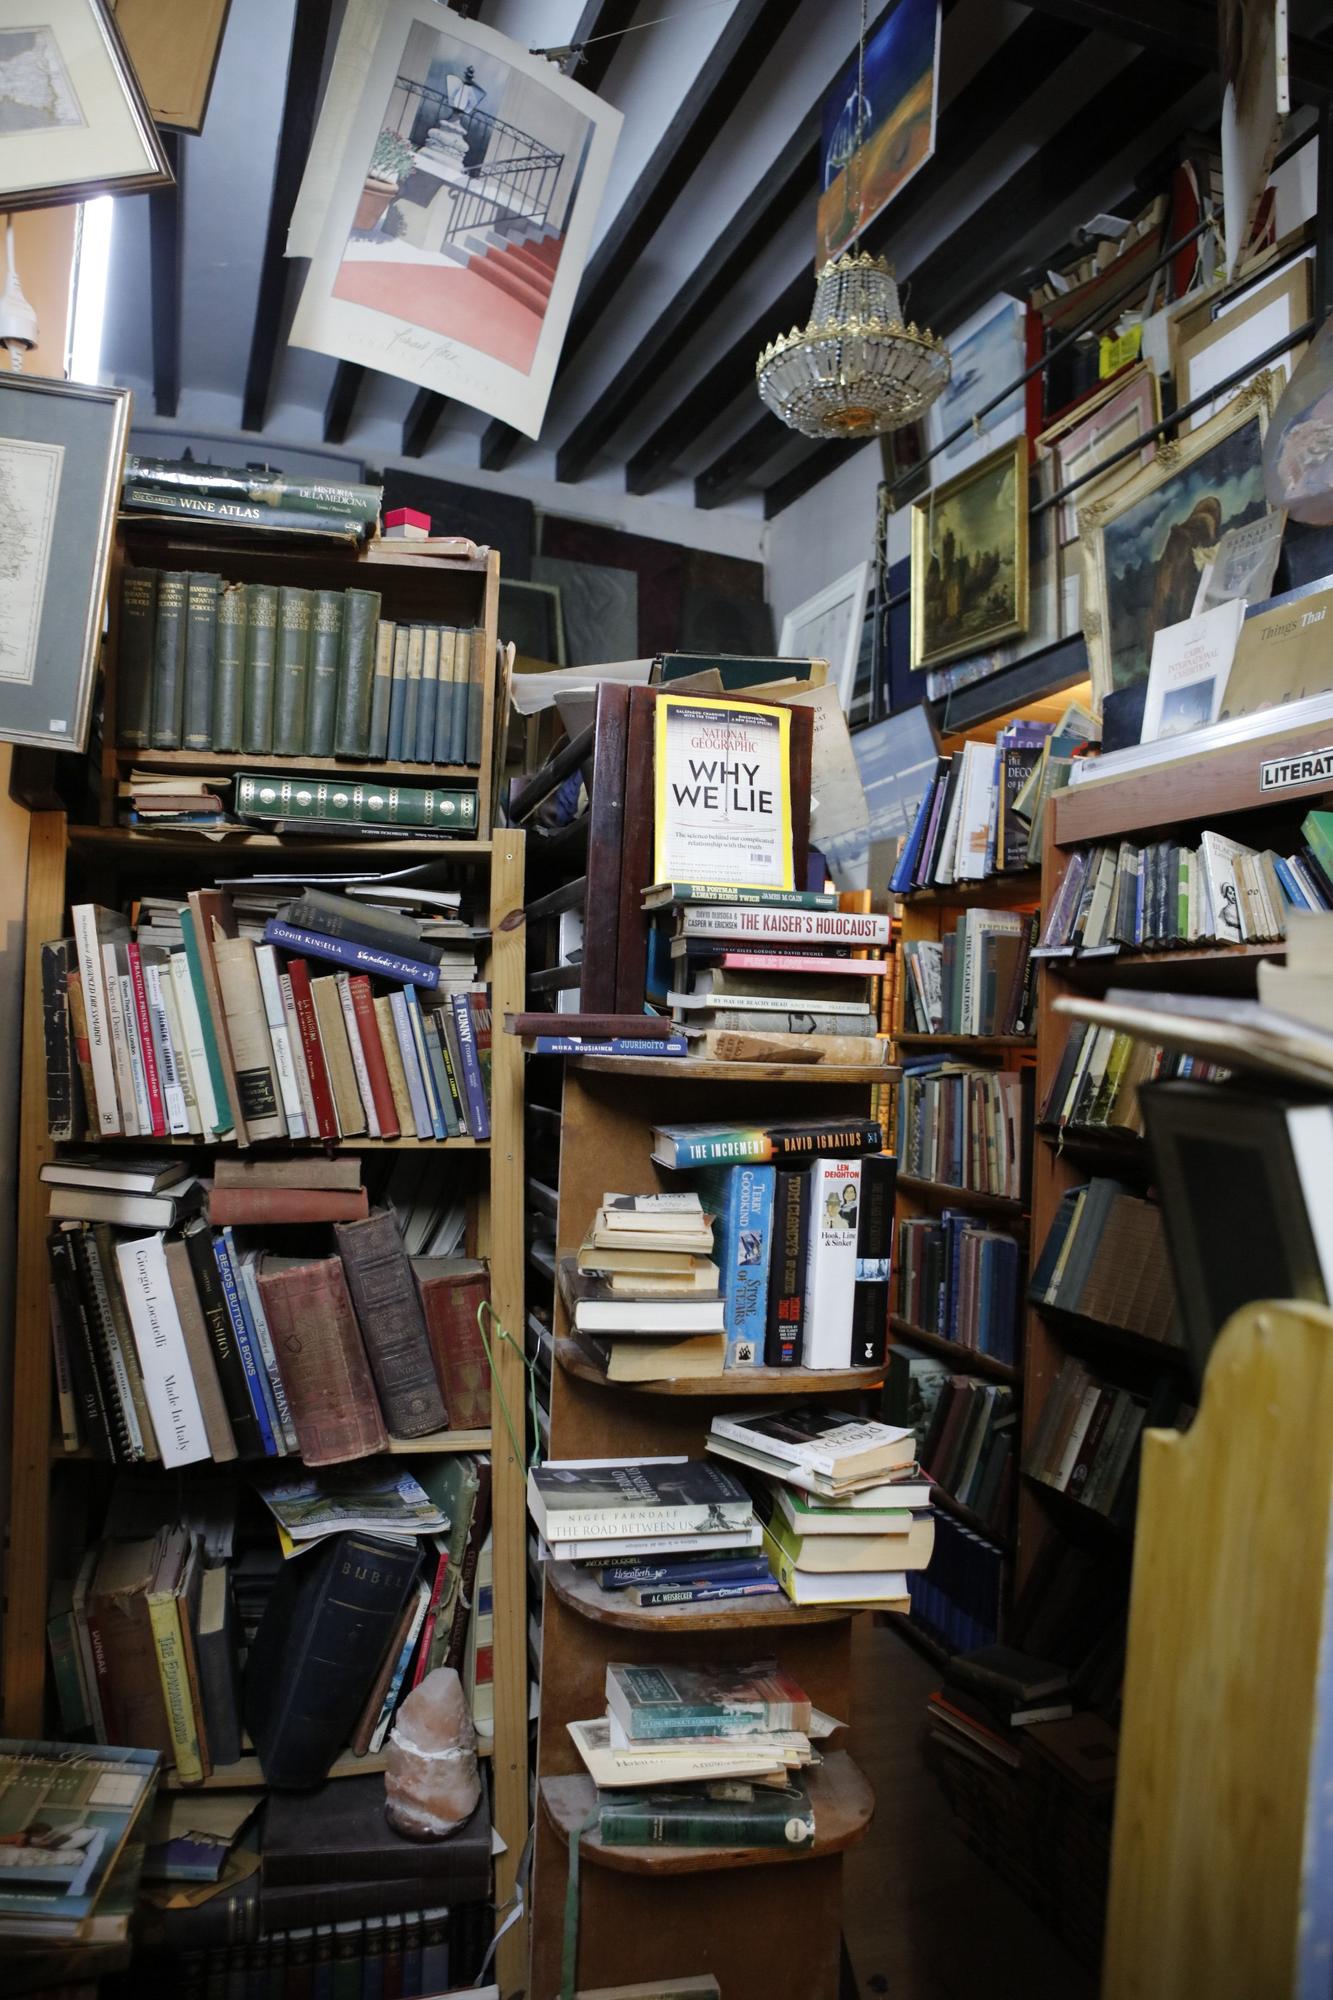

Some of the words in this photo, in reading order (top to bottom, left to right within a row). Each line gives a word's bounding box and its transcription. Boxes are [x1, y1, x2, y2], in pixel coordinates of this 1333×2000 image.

[314, 485, 353, 498] HISTORIA
[325, 491, 368, 508] MEDICINA
[180, 498, 216, 513] WINE
[219, 504, 260, 520] ATLAS
[1261, 620, 1297, 641] Things
[1300, 606, 1327, 627] Thai
[691, 737, 758, 752] GEOGRAPHIC
[702, 727, 748, 740] NATIONAL
[688, 760, 760, 786] WHY
[672, 783, 719, 809] WE
[734, 788, 773, 814] LIE
[688, 840, 722, 848] relationship
[691, 891, 717, 899] ALWAYS
[718, 892, 739, 900] RINGS
[739, 894, 760, 902] TWICE
[706, 886, 738, 894] POSTMAN
[687, 919, 707, 928] CASPER
[714, 920, 738, 929] ERICHSEN
[711, 911, 733, 920] OLUSOGA
[740, 913, 759, 931] THE
[763, 914, 813, 933] KAISER'S
[816, 917, 878, 937] HOLOCAUST
[273, 928, 302, 943] SOPHIE
[305, 936, 342, 953] KINSELLA
[85, 956, 97, 994] ADVANCED
[134, 961, 145, 1000] PRACTICAL
[964, 952, 972, 993] ENGLISH
[108, 975, 116, 1008] Objects
[90, 995, 102, 1046] DRESSMAKING
[112, 1008, 117, 1019] of
[139, 1002, 149, 1033] PRINCESS
[112, 1020, 121, 1041] Desire
[457, 1008, 471, 1043] FUNNY
[464, 1043, 473, 1067] STORIES
[144, 1037, 153, 1064] perfect
[620, 1040, 664, 1049] JUURIHOITO
[163, 1046, 174, 1082] LEADERSHIP
[149, 1065, 158, 1097] wardrobe
[689, 1144, 707, 1159] THE
[711, 1140, 765, 1159] INCREMENT
[784, 1137, 812, 1151] DAVID
[817, 1132, 861, 1148] IGNATIUS
[824, 1170, 860, 1178] DEIGHTON
[739, 1171, 754, 1227] GOODKIND
[752, 1184, 766, 1215] TERRY
[788, 1176, 801, 1203] TOM
[785, 1206, 800, 1257] CLANCY'S
[821, 1232, 841, 1240] Hook,
[825, 1239, 831, 1247] &
[832, 1239, 853, 1247] Sinker
[135, 1250, 151, 1293] Giorgio
[220, 1253, 235, 1291] BEADS,
[737, 1270, 748, 1282] OF
[734, 1283, 747, 1326] TEARS
[745, 1279, 761, 1318] STONE
[101, 1297, 118, 1351] DECORATOR
[146, 1296, 168, 1349] Locatelli
[228, 1293, 246, 1335] BUTTON
[240, 1335, 249, 1344] &
[242, 1345, 256, 1377] BOWS
[268, 1359, 278, 1376] ST
[164, 1374, 179, 1407] Made
[272, 1377, 292, 1424] ALBANS
[171, 1408, 181, 1421] In
[177, 1424, 190, 1451] Italy
[809, 1425, 884, 1452] Ackroyd
[555, 1526, 579, 1537] THE
[583, 1523, 617, 1536] ROAD
[621, 1521, 677, 1533] BETWEEN
[679, 1520, 694, 1531] US
[568, 1514, 606, 1522] NIGEL
[614, 1510, 679, 1521] FARNDALE
[663, 1592, 693, 1601] WEISBECKER
[165, 1661, 188, 1744] EDWARDIANS
